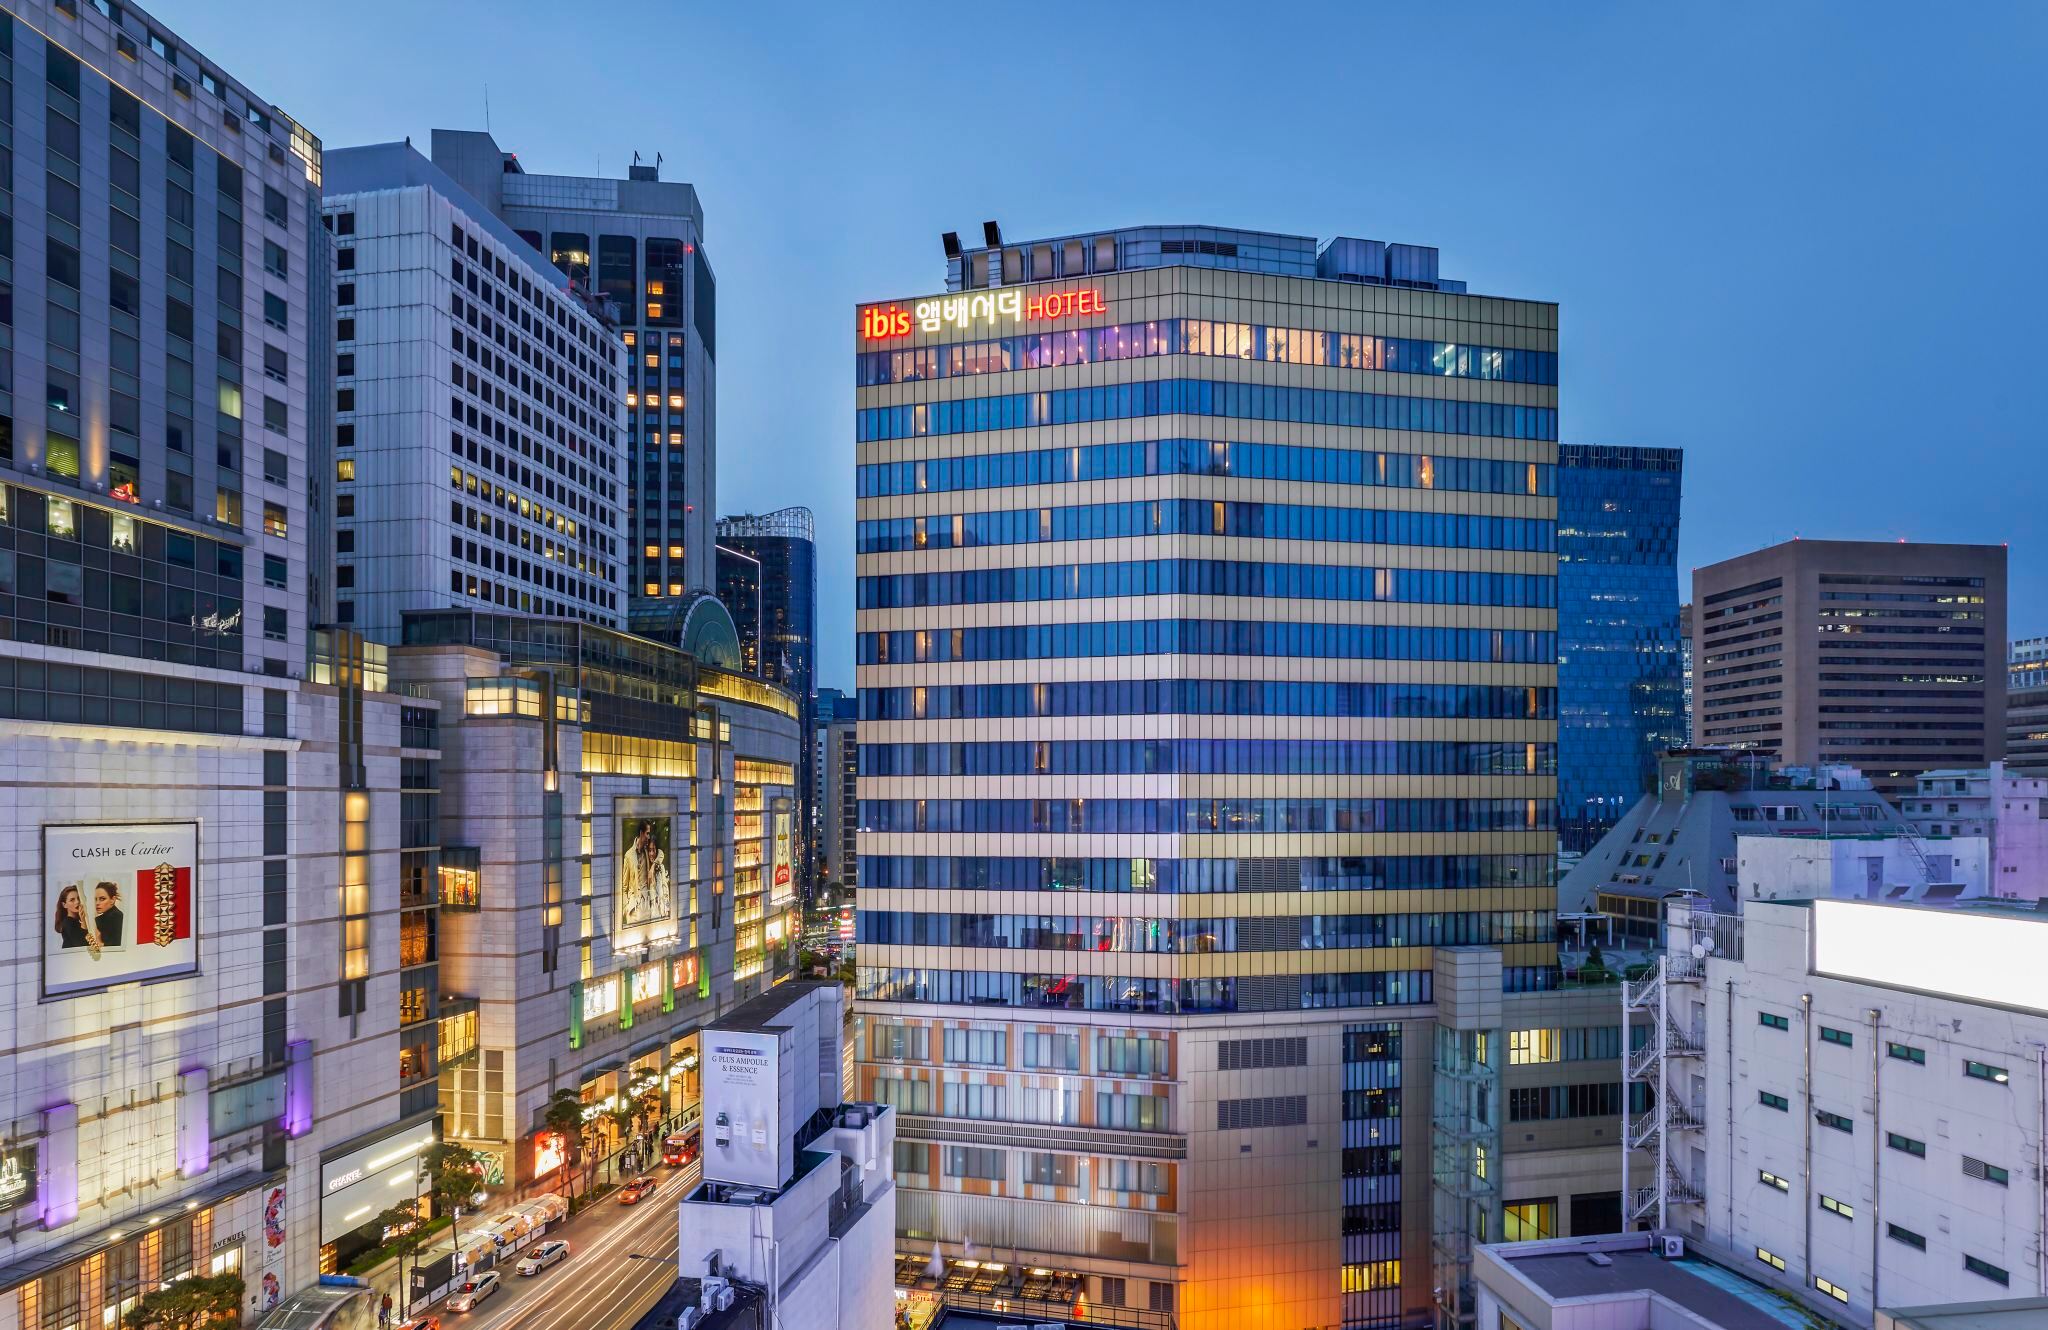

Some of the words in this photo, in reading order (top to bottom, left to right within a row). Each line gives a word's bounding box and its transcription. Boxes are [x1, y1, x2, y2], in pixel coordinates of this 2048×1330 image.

[864, 305, 911, 338] ibis
[916, 290, 1021, 332] 앰배서더
[1027, 289, 1106, 319] HOTEL
[72, 847, 110, 858] CLASH
[115, 848, 127, 857] DE
[130, 841, 174, 856] Cartier
[722, 1064, 728, 1072] &
[729, 1065, 758, 1074] ESSENCE
[736, 1057, 768, 1066] AMPOULE
[212, 1231, 246, 1250] AVENUEL
